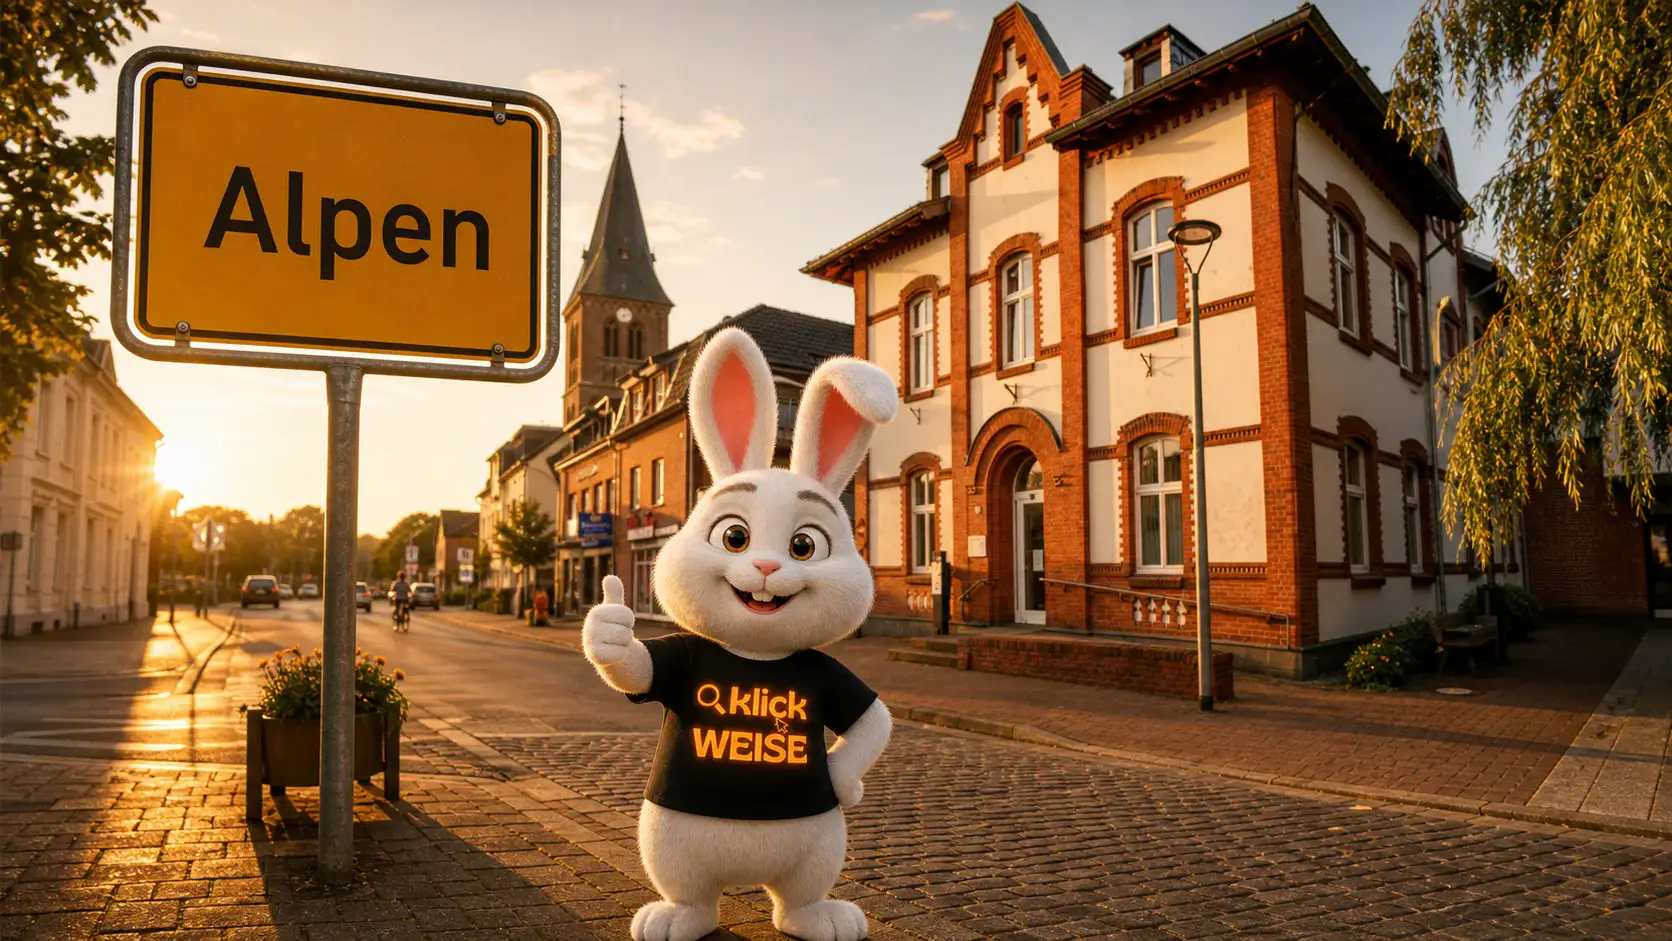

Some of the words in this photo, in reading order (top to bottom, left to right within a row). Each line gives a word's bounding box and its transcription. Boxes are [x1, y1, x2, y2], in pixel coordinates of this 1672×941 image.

[204, 166, 490, 281] Alpen
[729, 686, 807, 720] klick
[693, 727, 808, 764] WEISE
